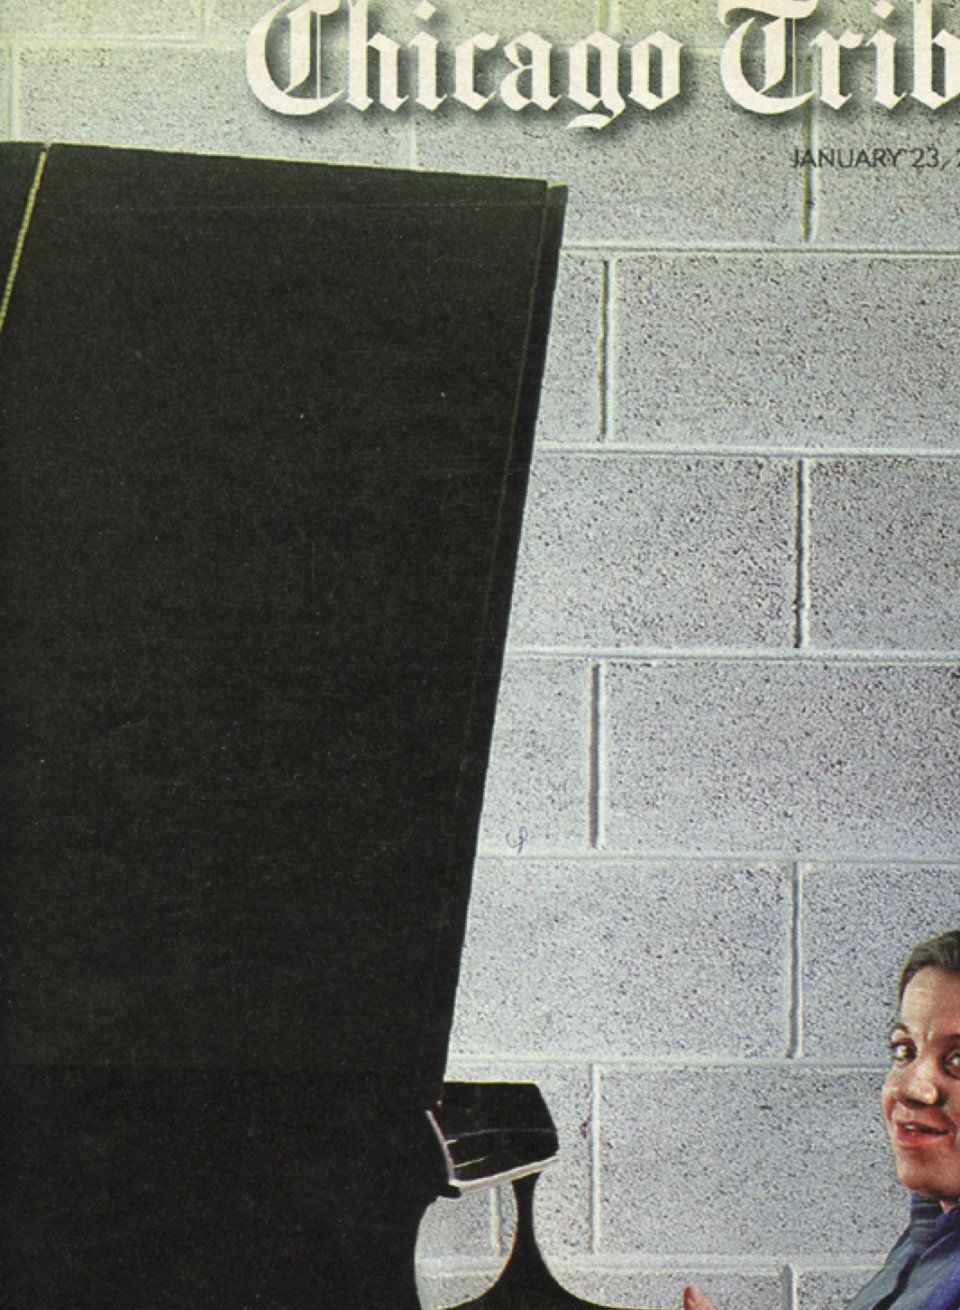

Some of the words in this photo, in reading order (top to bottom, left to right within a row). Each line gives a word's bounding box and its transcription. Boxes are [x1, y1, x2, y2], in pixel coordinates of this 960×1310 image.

[245, 0, 684, 129] Chicago
[791, 148, 902, 169] JANUARY
[913, 148, 947, 172] 23,
